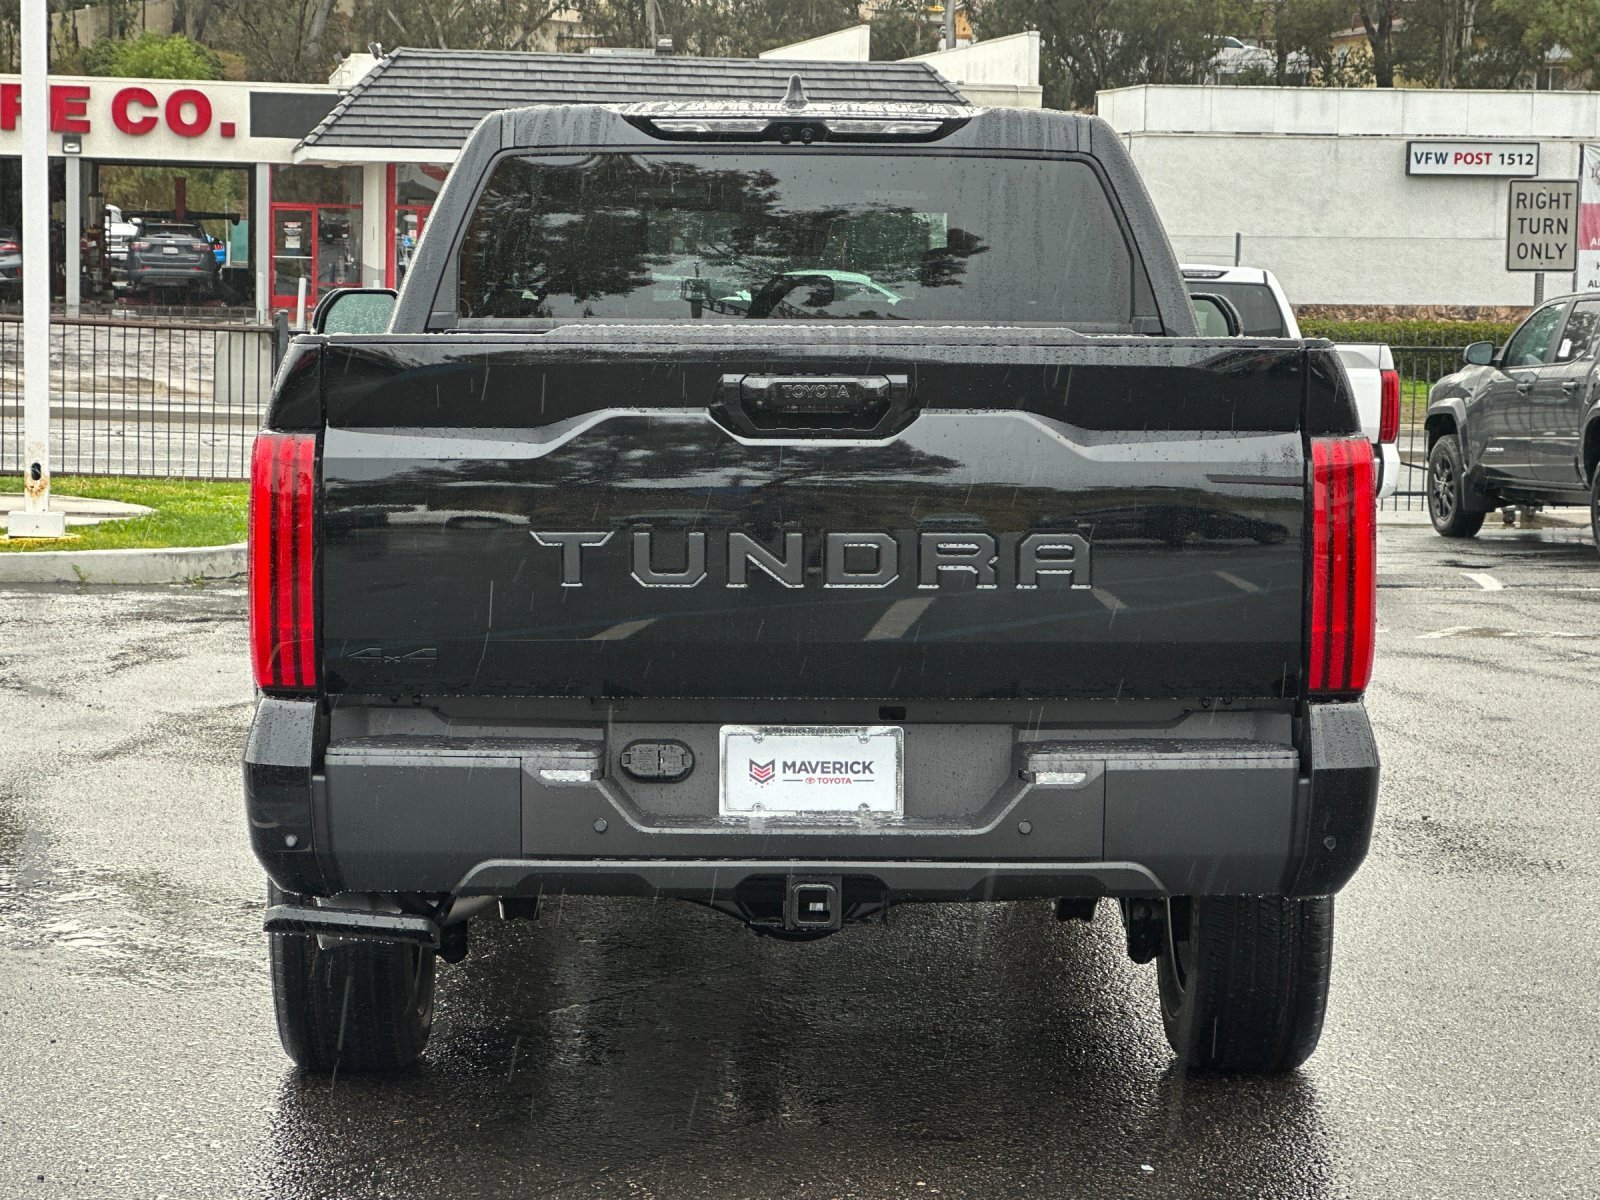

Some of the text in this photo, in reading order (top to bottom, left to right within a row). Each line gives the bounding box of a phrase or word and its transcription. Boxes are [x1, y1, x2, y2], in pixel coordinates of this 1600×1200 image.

[111, 87, 236, 138] CO.
[1413, 151, 1535, 166] VFW POST 1512
[1515, 192, 1573, 210] RIGHT
[1517, 217, 1569, 235] TURN
[1516, 242, 1568, 260] ONLY
[782, 384, 850, 399] TOYOTA
[528, 530, 1093, 590] TUNDRA
[782, 760, 875, 774] MAVERICK
[817, 777, 852, 785] TOYOTA
